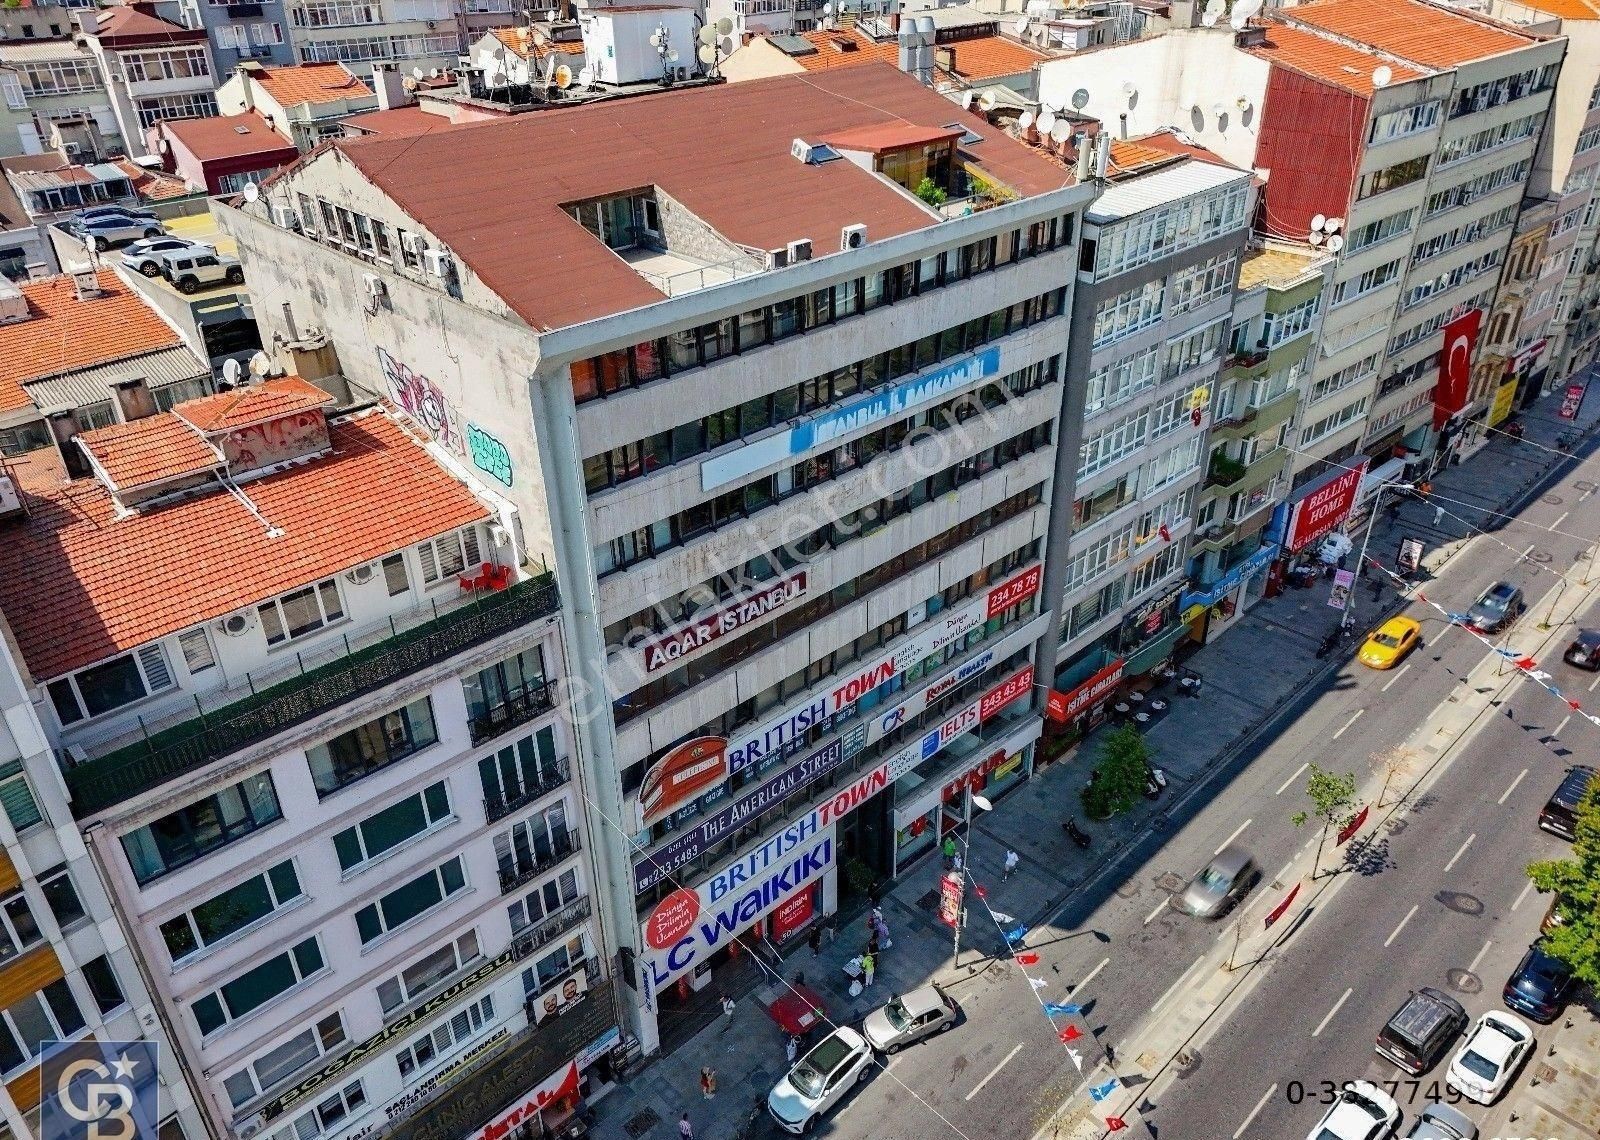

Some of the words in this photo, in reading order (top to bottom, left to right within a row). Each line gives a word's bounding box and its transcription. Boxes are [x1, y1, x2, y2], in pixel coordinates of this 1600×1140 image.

[1309, 494, 1346, 525] HOME
[991, 589, 1010, 608] 234
[1011, 581, 1024, 597] 78
[1025, 571, 1038, 588] 78
[649, 624, 712, 670] AQAR
[982, 691, 1002, 712] 343
[1004, 681, 1017, 697] 43
[1017, 672, 1031, 688] 43
[728, 696, 827, 776] BRITISH
[832, 656, 895, 711] TOWN
[940, 705, 977, 741] IELTS
[701, 815, 727, 842] THE
[730, 771, 795, 825] AMERICAN
[800, 742, 840, 780] STREET
[709, 811, 817, 904] BRITISH
[819, 764, 888, 827] TOWN
[653, 861, 672, 882] 233
[674, 844, 699, 869] 5483
[650, 936, 697, 987] LC
[279, 1010, 417, 1106] BOĞAZİÇİ
[424, 953, 511, 1013] KURSU
